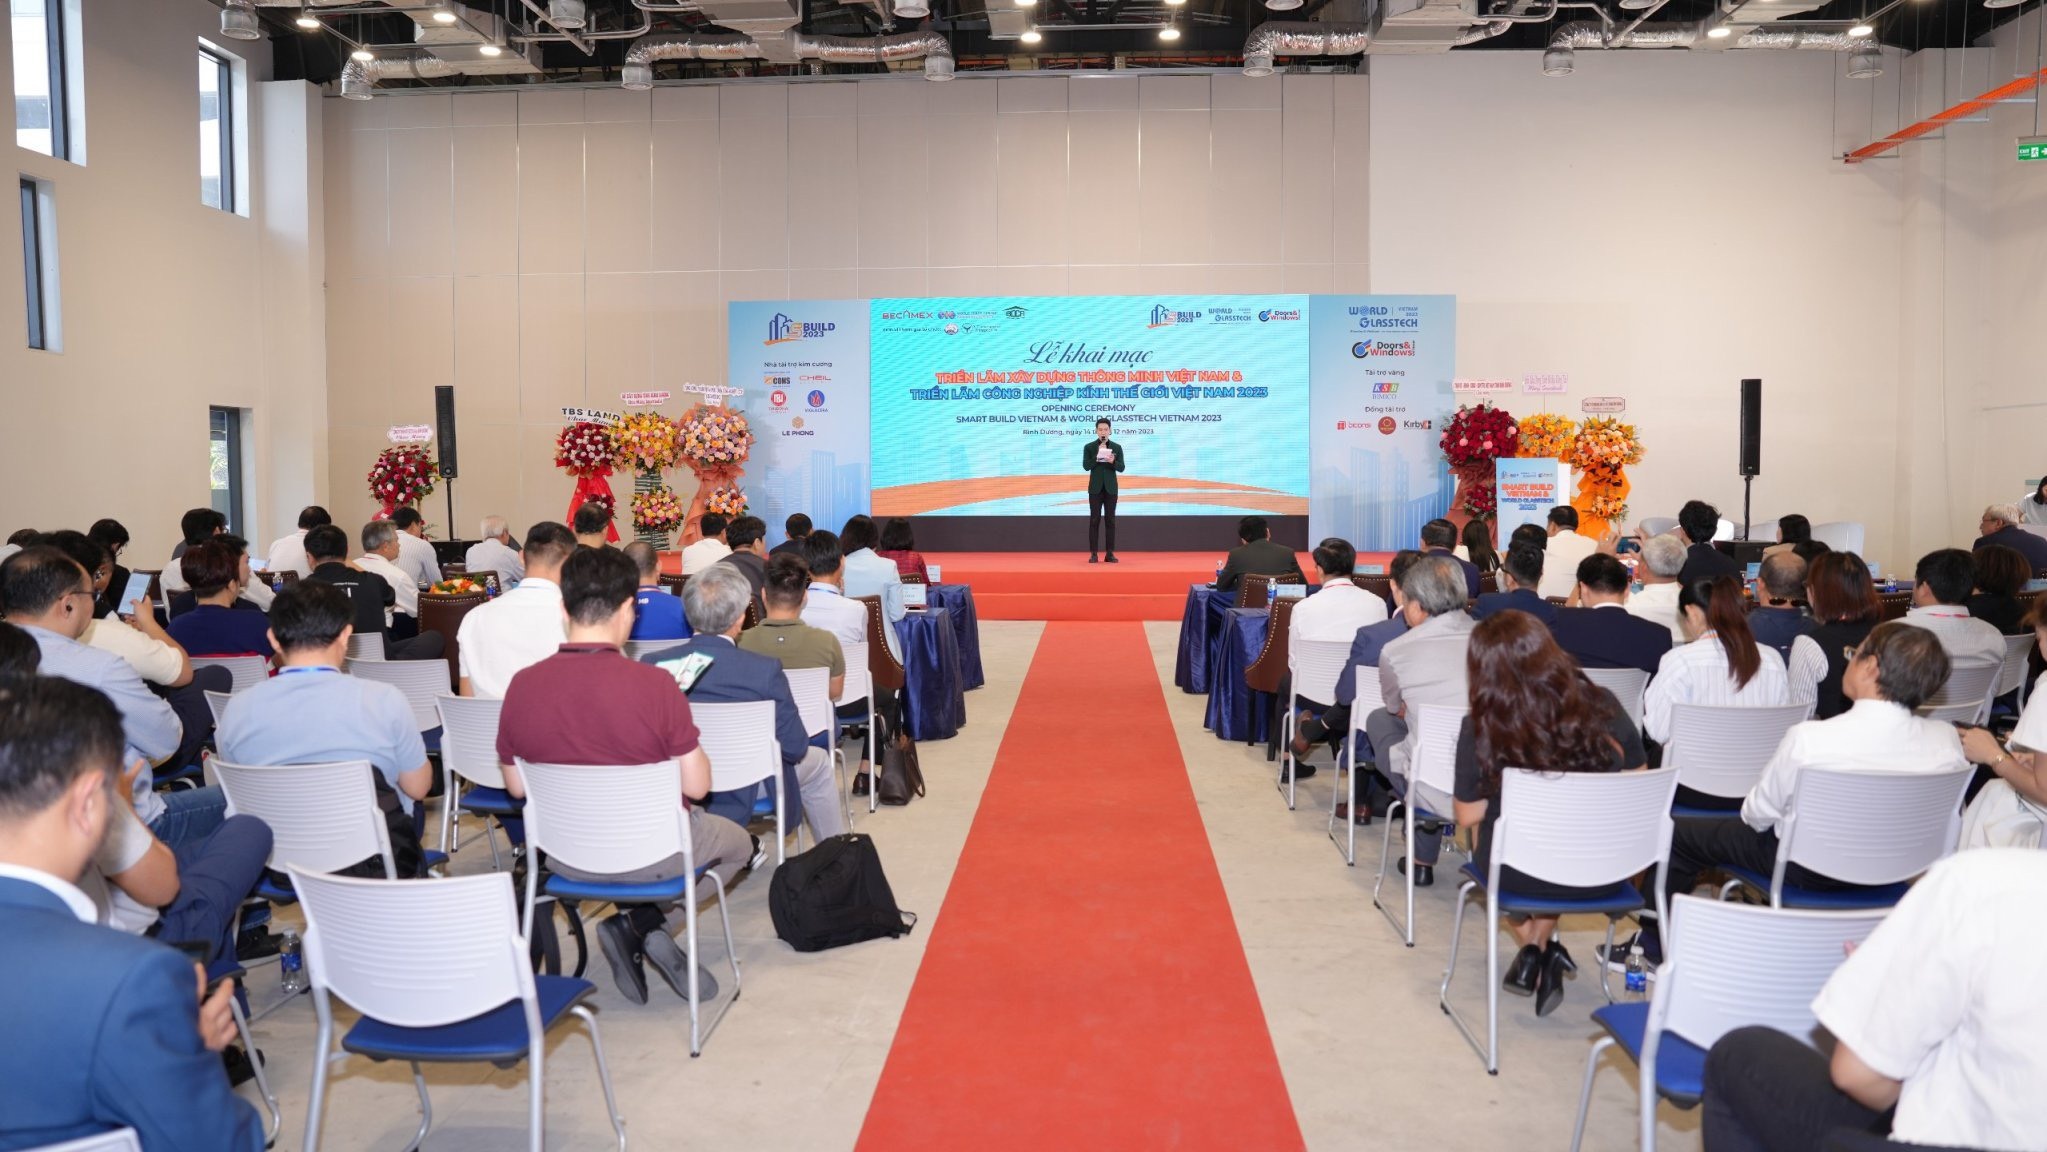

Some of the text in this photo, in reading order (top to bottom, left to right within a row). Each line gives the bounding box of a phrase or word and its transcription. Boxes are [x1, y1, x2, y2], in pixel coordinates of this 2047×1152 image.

[1348, 306, 1388, 316] WORLD
[803, 323, 836, 331] BUILD
[1360, 317, 1418, 328] GLASSTECH
[1023, 340, 1154, 368] Lễ khai mạc
[936, 368, 1243, 384] TRIỂN LÃM XÂY DỰNG THÔNG MINH VIỆT NAM &
[910, 384, 1268, 401] TRIỂN LÃM CÔNG NGHIỆP KÍNH THẾ GIỚI VIỆT NAM 2023
[1374, 384, 1398, 392] KSB
[588, 410, 621, 421] LAND
[1404, 420, 1424, 429] Kirby
